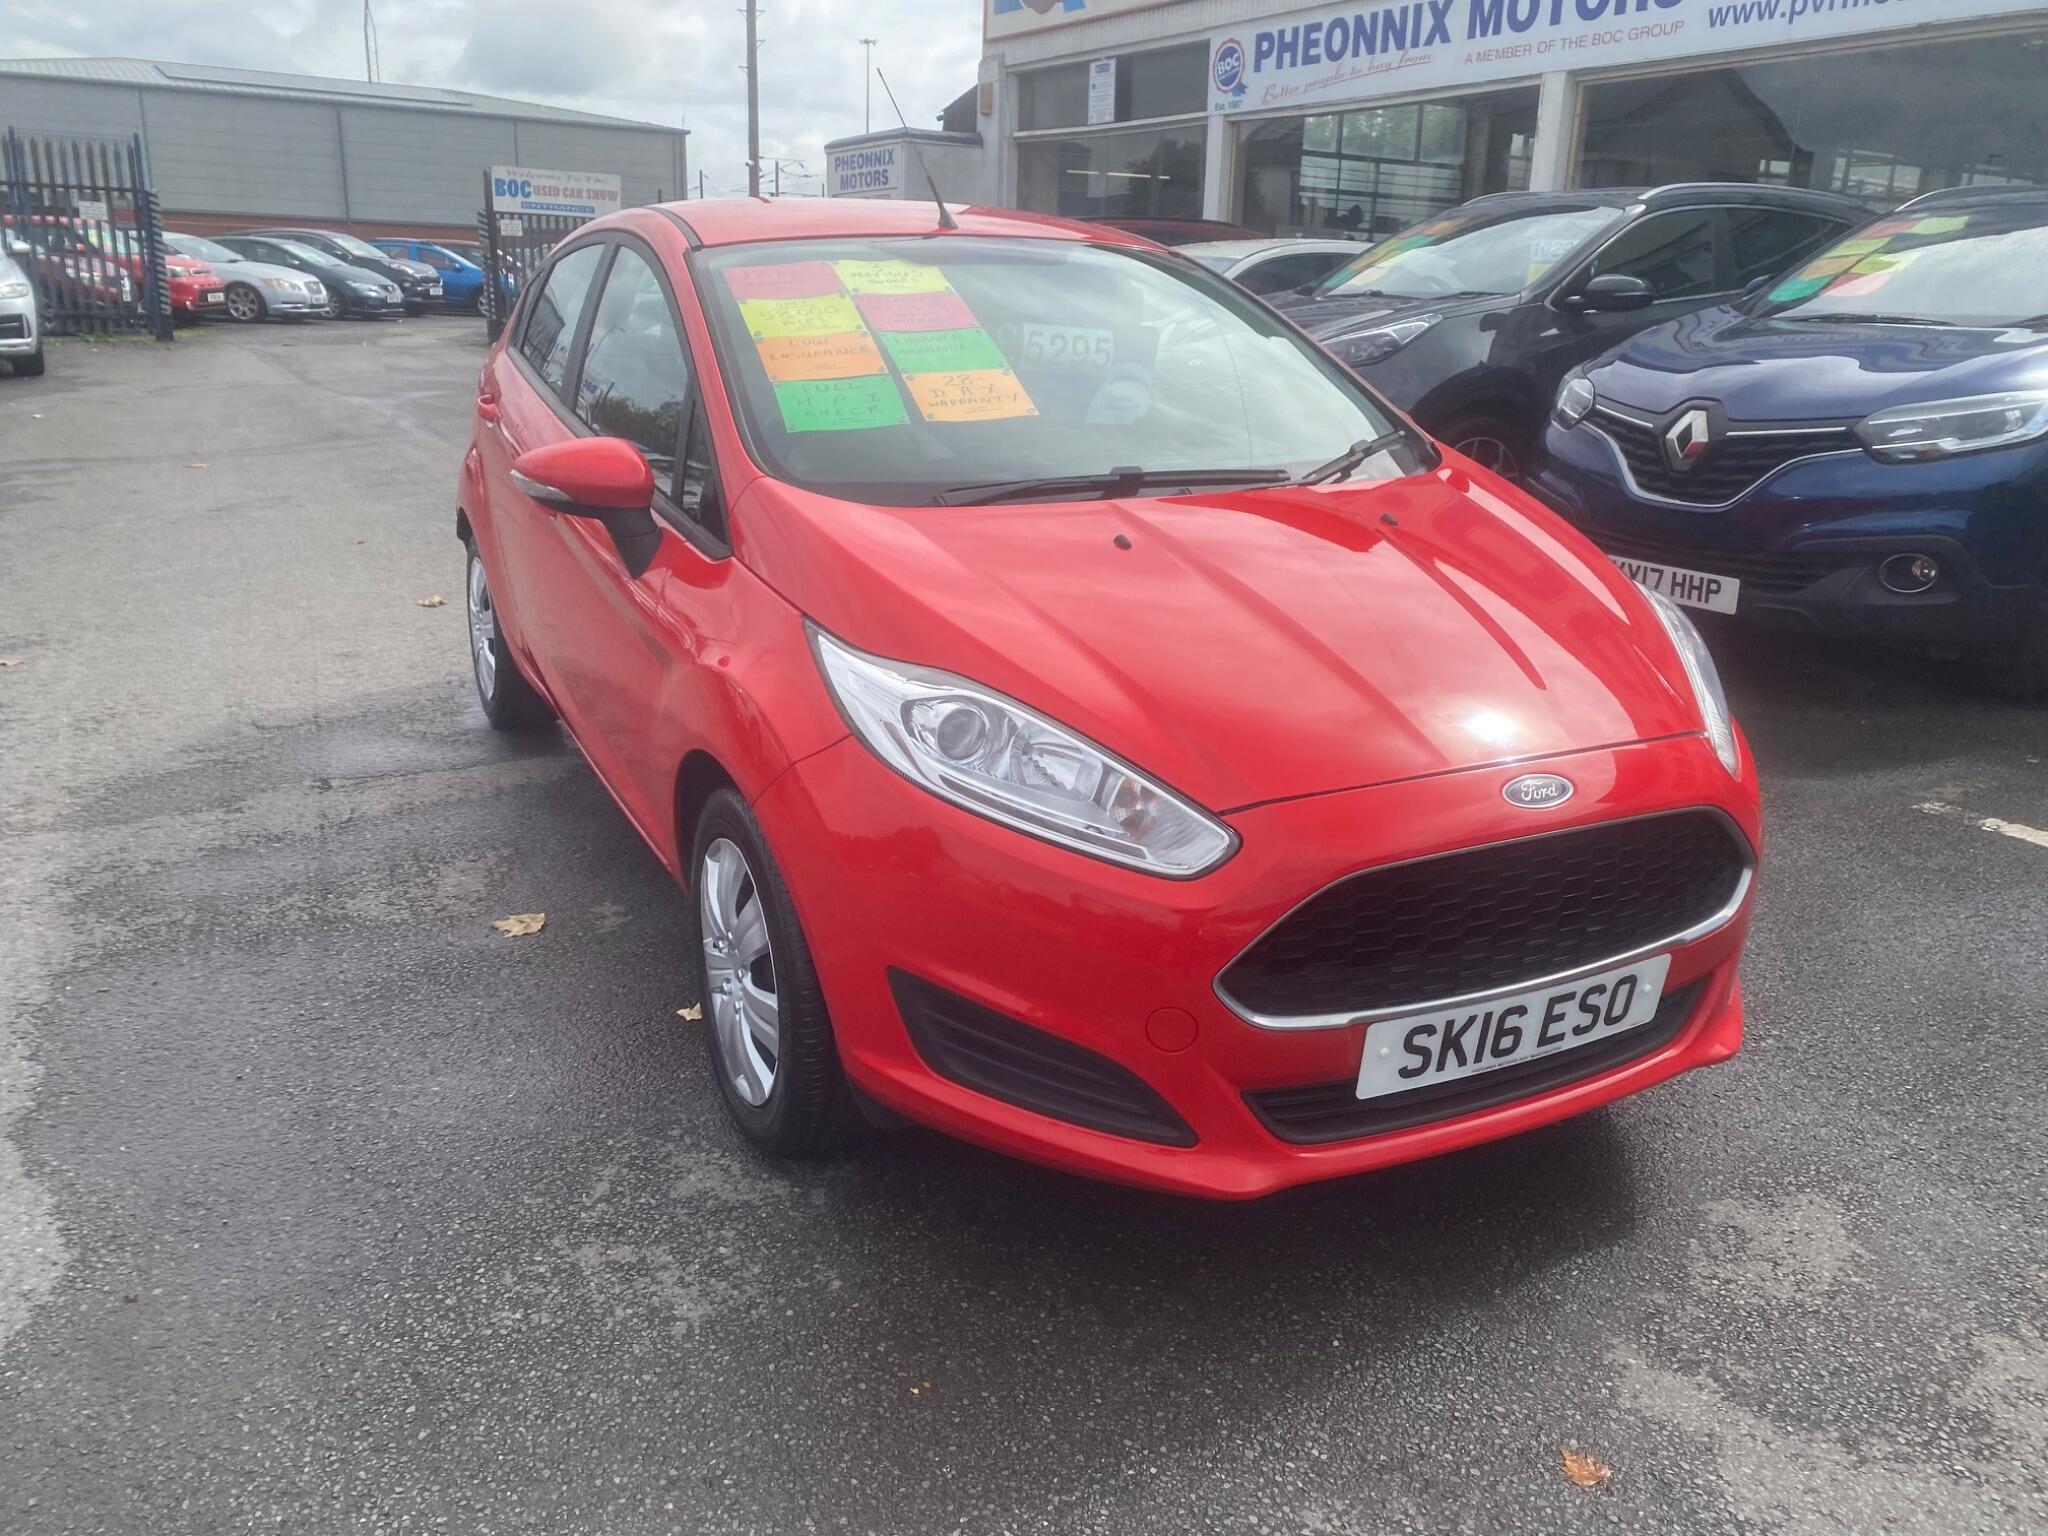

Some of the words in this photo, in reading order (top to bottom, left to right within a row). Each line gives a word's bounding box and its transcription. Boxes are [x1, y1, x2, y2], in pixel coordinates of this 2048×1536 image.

[1253, 0, 1452, 73] PHEONNIX
[1464, 52, 1473, 65] A
[1475, 44, 1532, 63] MEMBER
[1536, 39, 1557, 55] OF
[1560, 34, 1589, 51] THE
[1591, 29, 1624, 46] BOC
[1627, 20, 1686, 41] GROUP
[1217, 53, 1240, 75] BOC
[1303, 62, 1346, 95] people
[1350, 65, 1364, 78] to
[1367, 55, 1393, 76] buy
[834, 147, 895, 173] PHEONNIX
[494, 178, 532, 199] BOC
[533, 184, 560, 198] USED
[562, 186, 584, 200] CAR
[839, 168, 889, 191] MOTORS
[768, 345, 872, 361] INSURANCE
[788, 337, 828, 346] LOW
[801, 382, 865, 393] FULL
[804, 403, 880, 417] CHECK
[927, 392, 1018, 408] WARRANTY
[1670, 570, 1722, 604] HHP
[1520, 779, 1558, 802] Ford
[1397, 1004, 1529, 1080] SK16
[1536, 973, 1639, 1049] ESO
